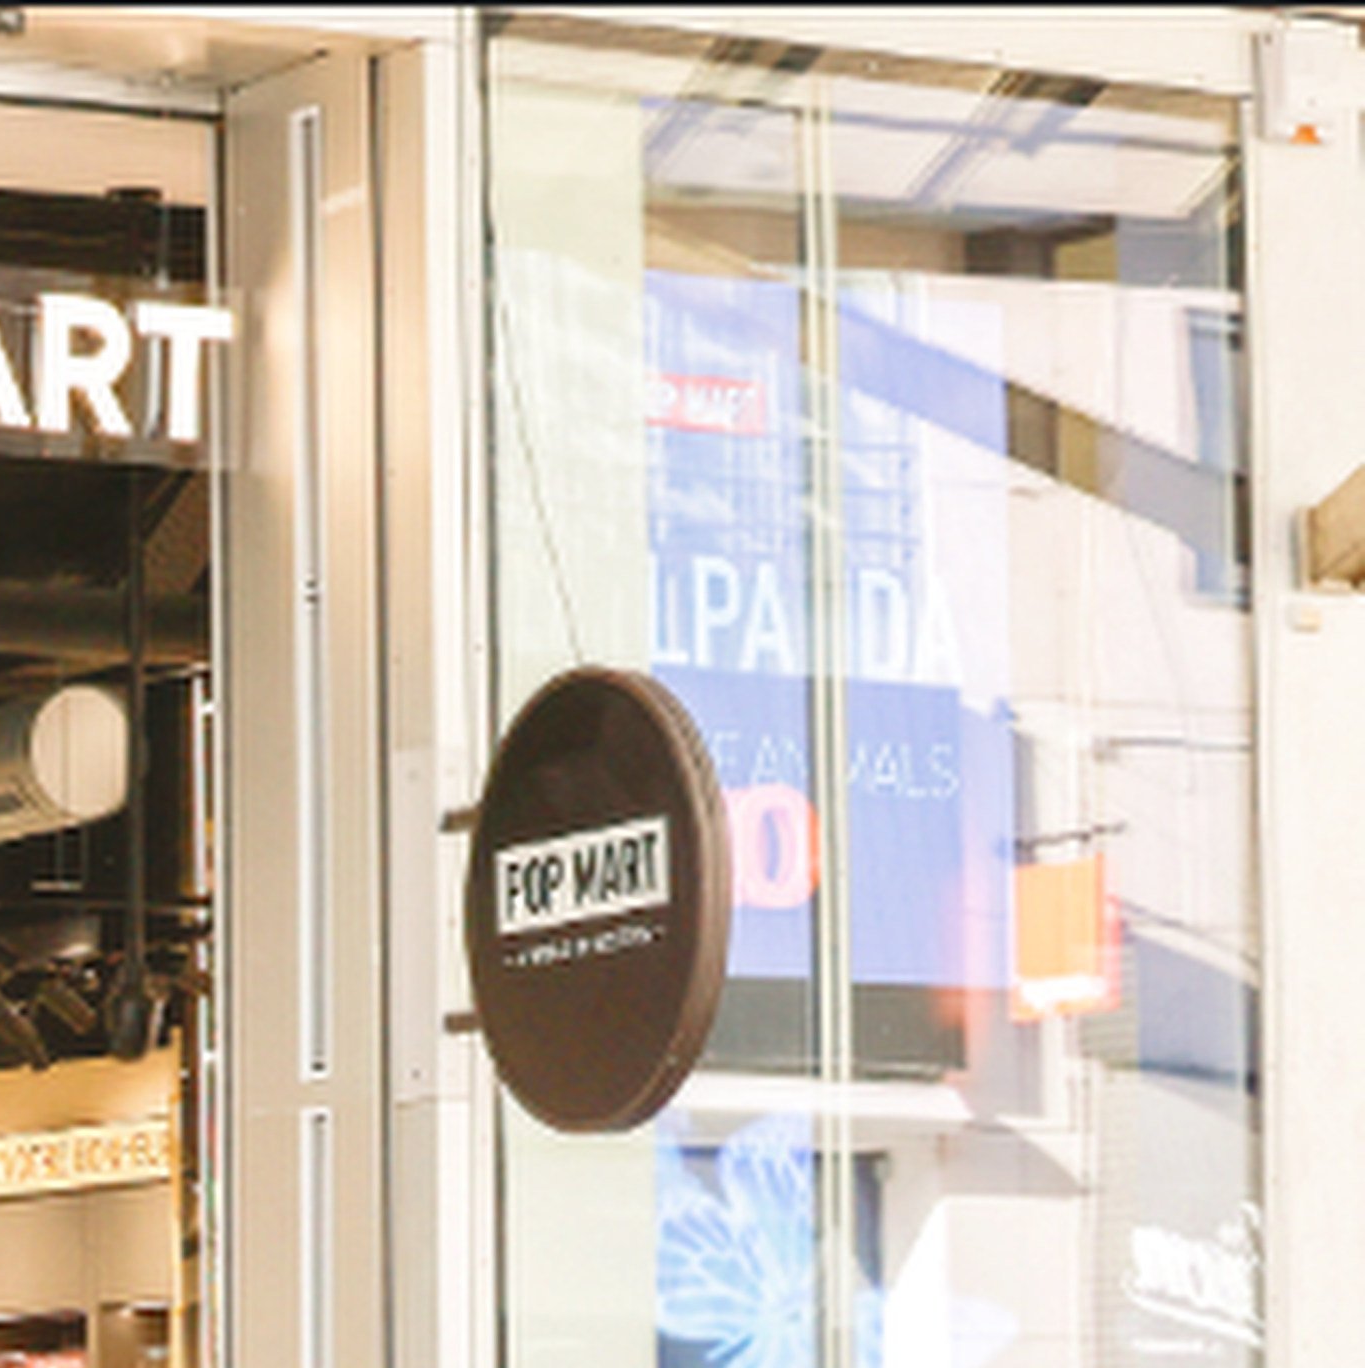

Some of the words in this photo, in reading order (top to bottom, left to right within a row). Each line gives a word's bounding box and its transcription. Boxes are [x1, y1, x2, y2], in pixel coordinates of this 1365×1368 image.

[647, 552, 963, 684] LPADA
[749, 736, 961, 799] ANALS
[506, 854, 565, 922] POP
[572, 832, 658, 905] MART
